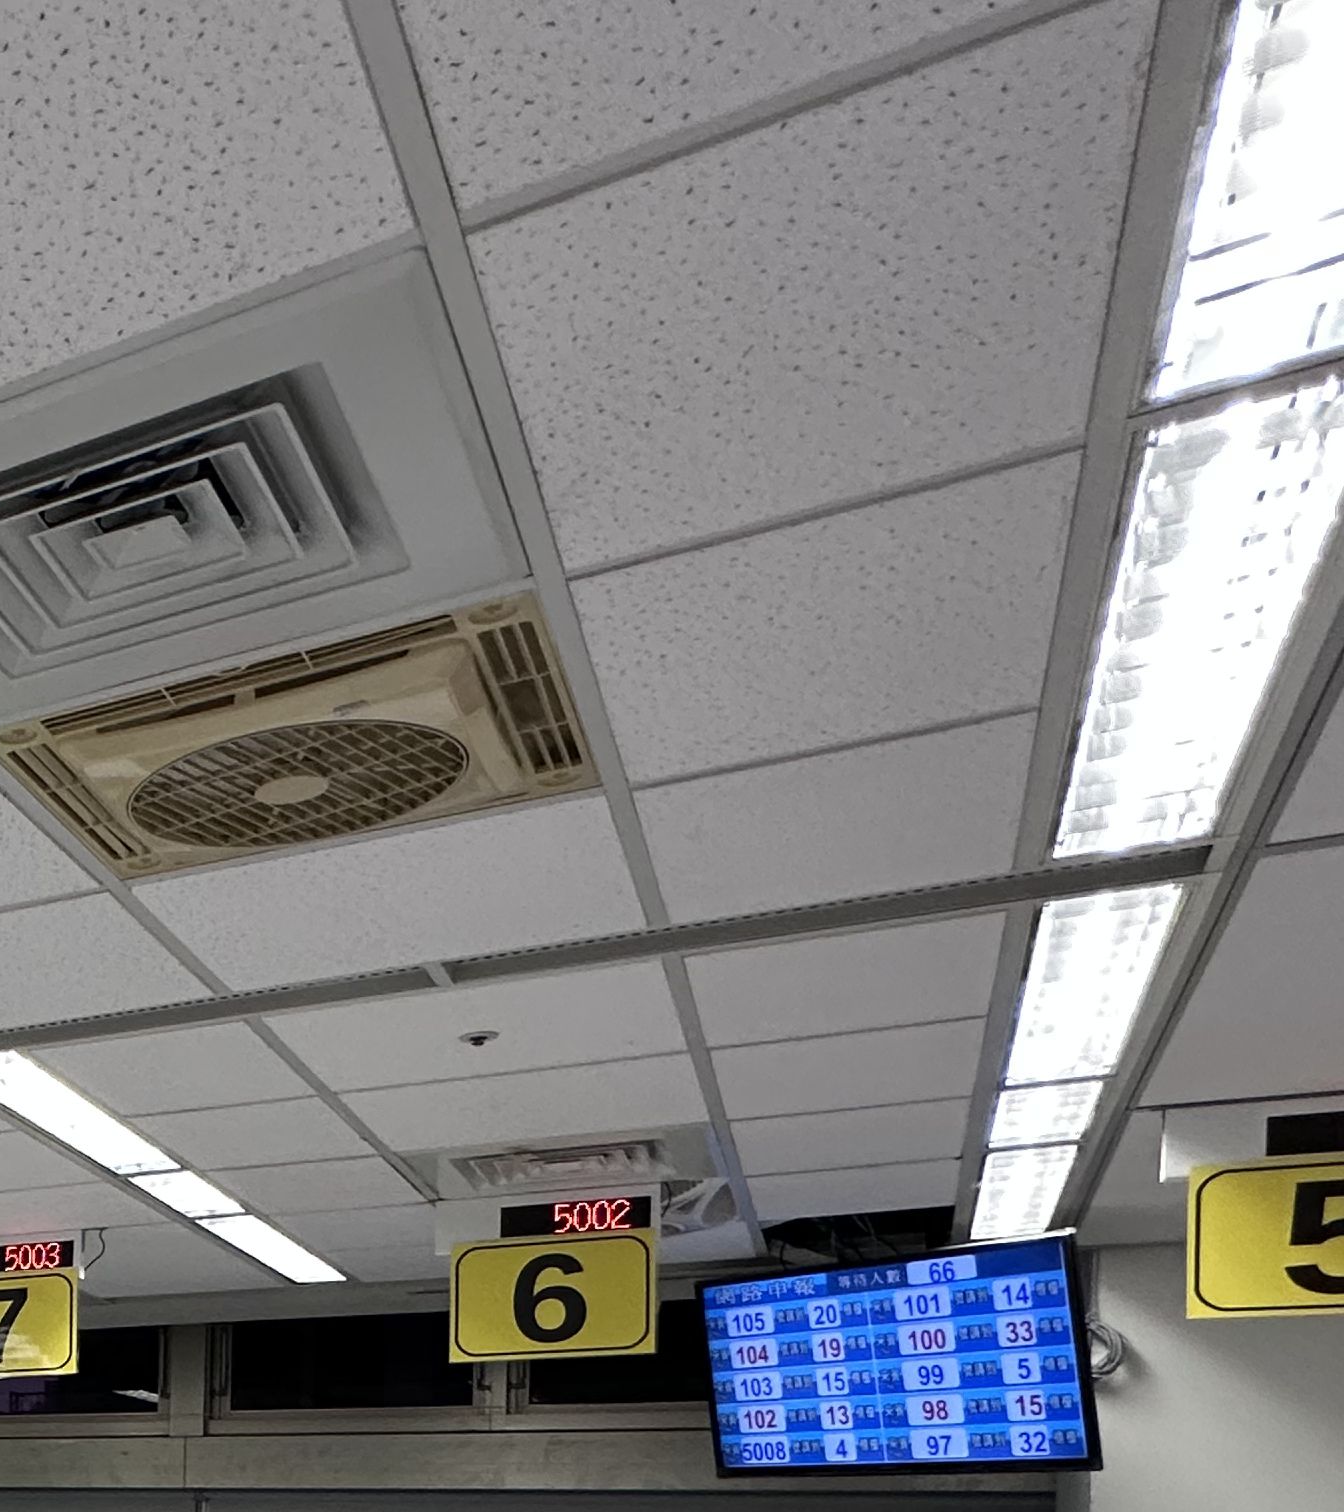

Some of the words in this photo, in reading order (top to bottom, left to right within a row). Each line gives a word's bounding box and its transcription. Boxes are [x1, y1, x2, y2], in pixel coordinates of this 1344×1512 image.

[554, 1199, 631, 1233] 5002
[1285, 1179, 1344, 1294] 5
[4, 1242, 60, 1271] 5003
[928, 1260, 955, 1283] 66
[513, 1252, 587, 1343] 6
[732, 1312, 765, 1334] 105
[813, 1304, 838, 1326] 20
[903, 1293, 941, 1316] 101
[1001, 1282, 1030, 1306] 14
[736, 1344, 769, 1365] 104
[818, 1338, 841, 1359] 19
[908, 1328, 946, 1351] 100
[1005, 1320, 1034, 1343] 33
[740, 1377, 773, 1398] 103
[822, 1371, 846, 1392] 15
[918, 1364, 944, 1386] 99
[1017, 1358, 1031, 1380] 5
[744, 1409, 778, 1430] 102
[826, 1405, 850, 1426] 13
[922, 1400, 948, 1421] 98
[1015, 1395, 1042, 1417] 15
[742, 1441, 787, 1462] 5008
[835, 1439, 848, 1459] 4
[926, 1435, 952, 1456] 97
[1018, 1431, 1048, 1454] 32
